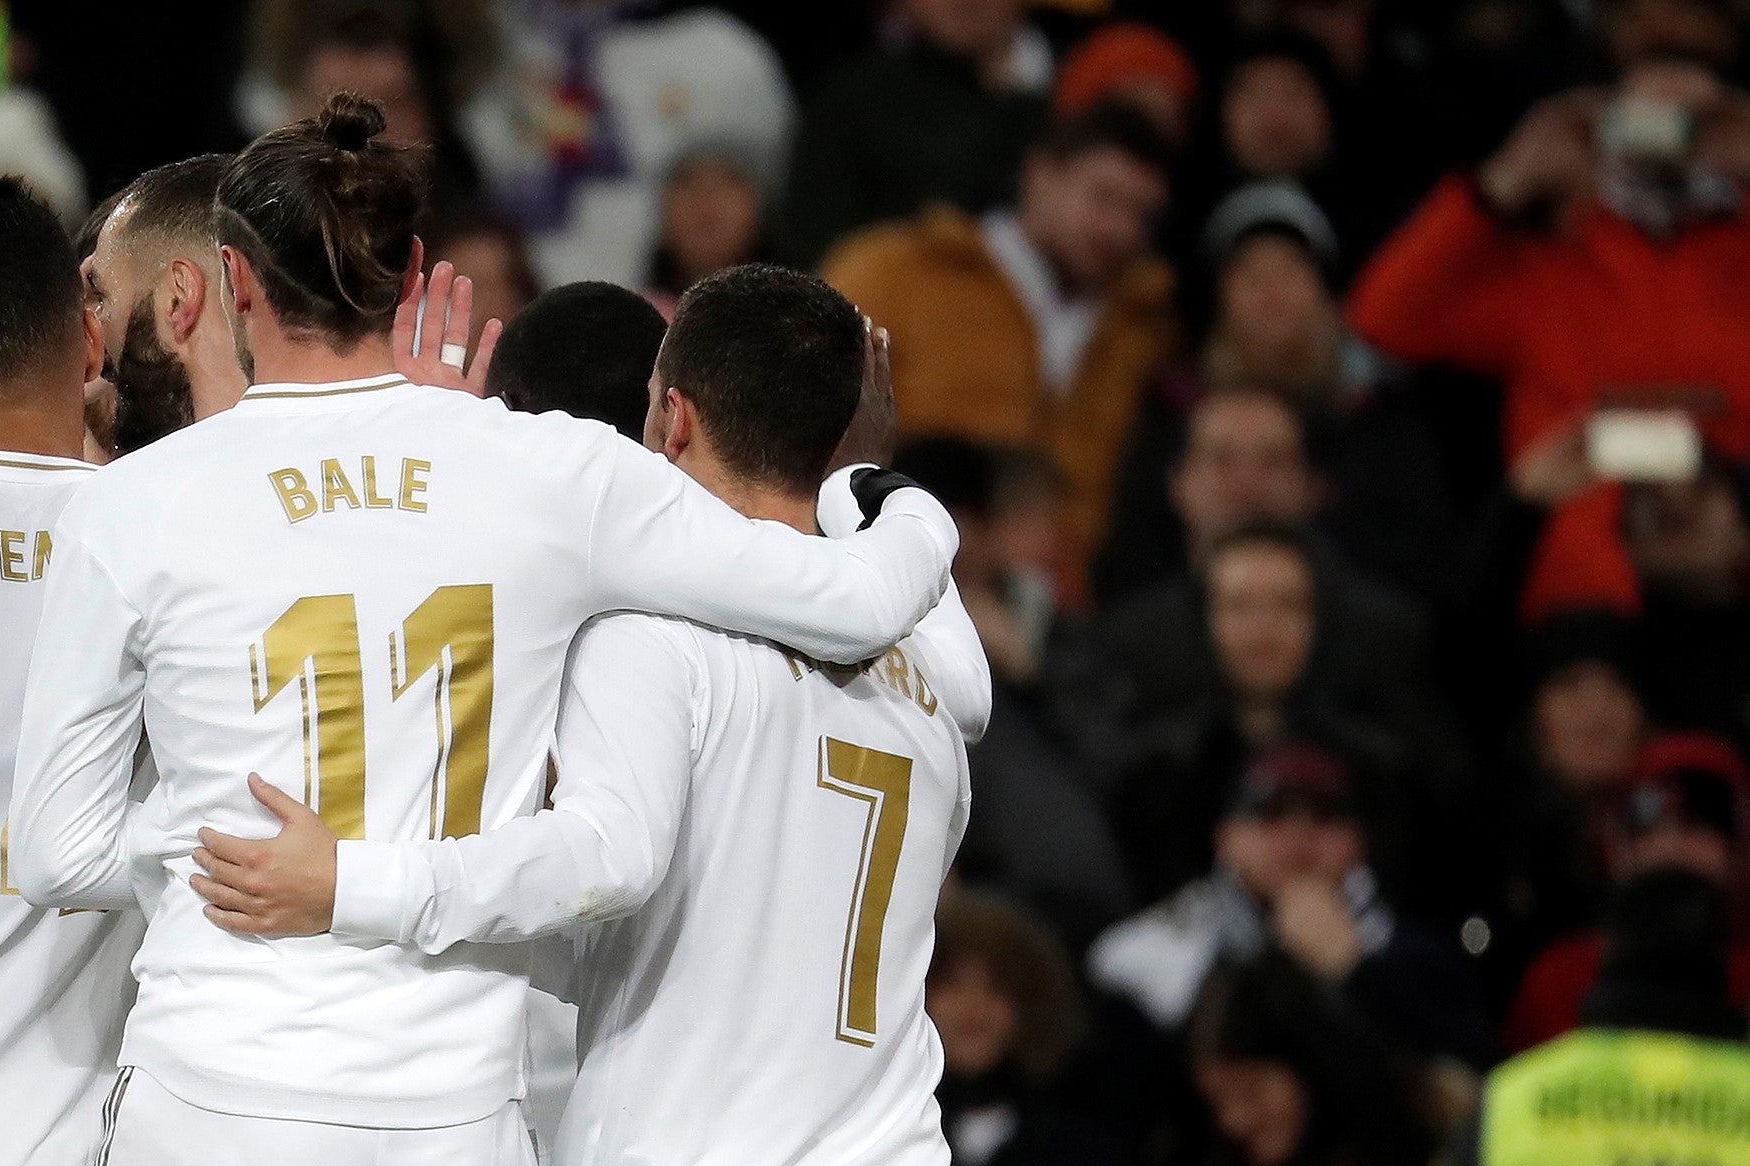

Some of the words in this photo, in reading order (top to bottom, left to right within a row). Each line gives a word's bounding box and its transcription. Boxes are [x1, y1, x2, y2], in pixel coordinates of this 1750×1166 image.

[269, 455, 432, 524] BALE
[248, 583, 495, 841] 11
[817, 734, 914, 1049] 7
